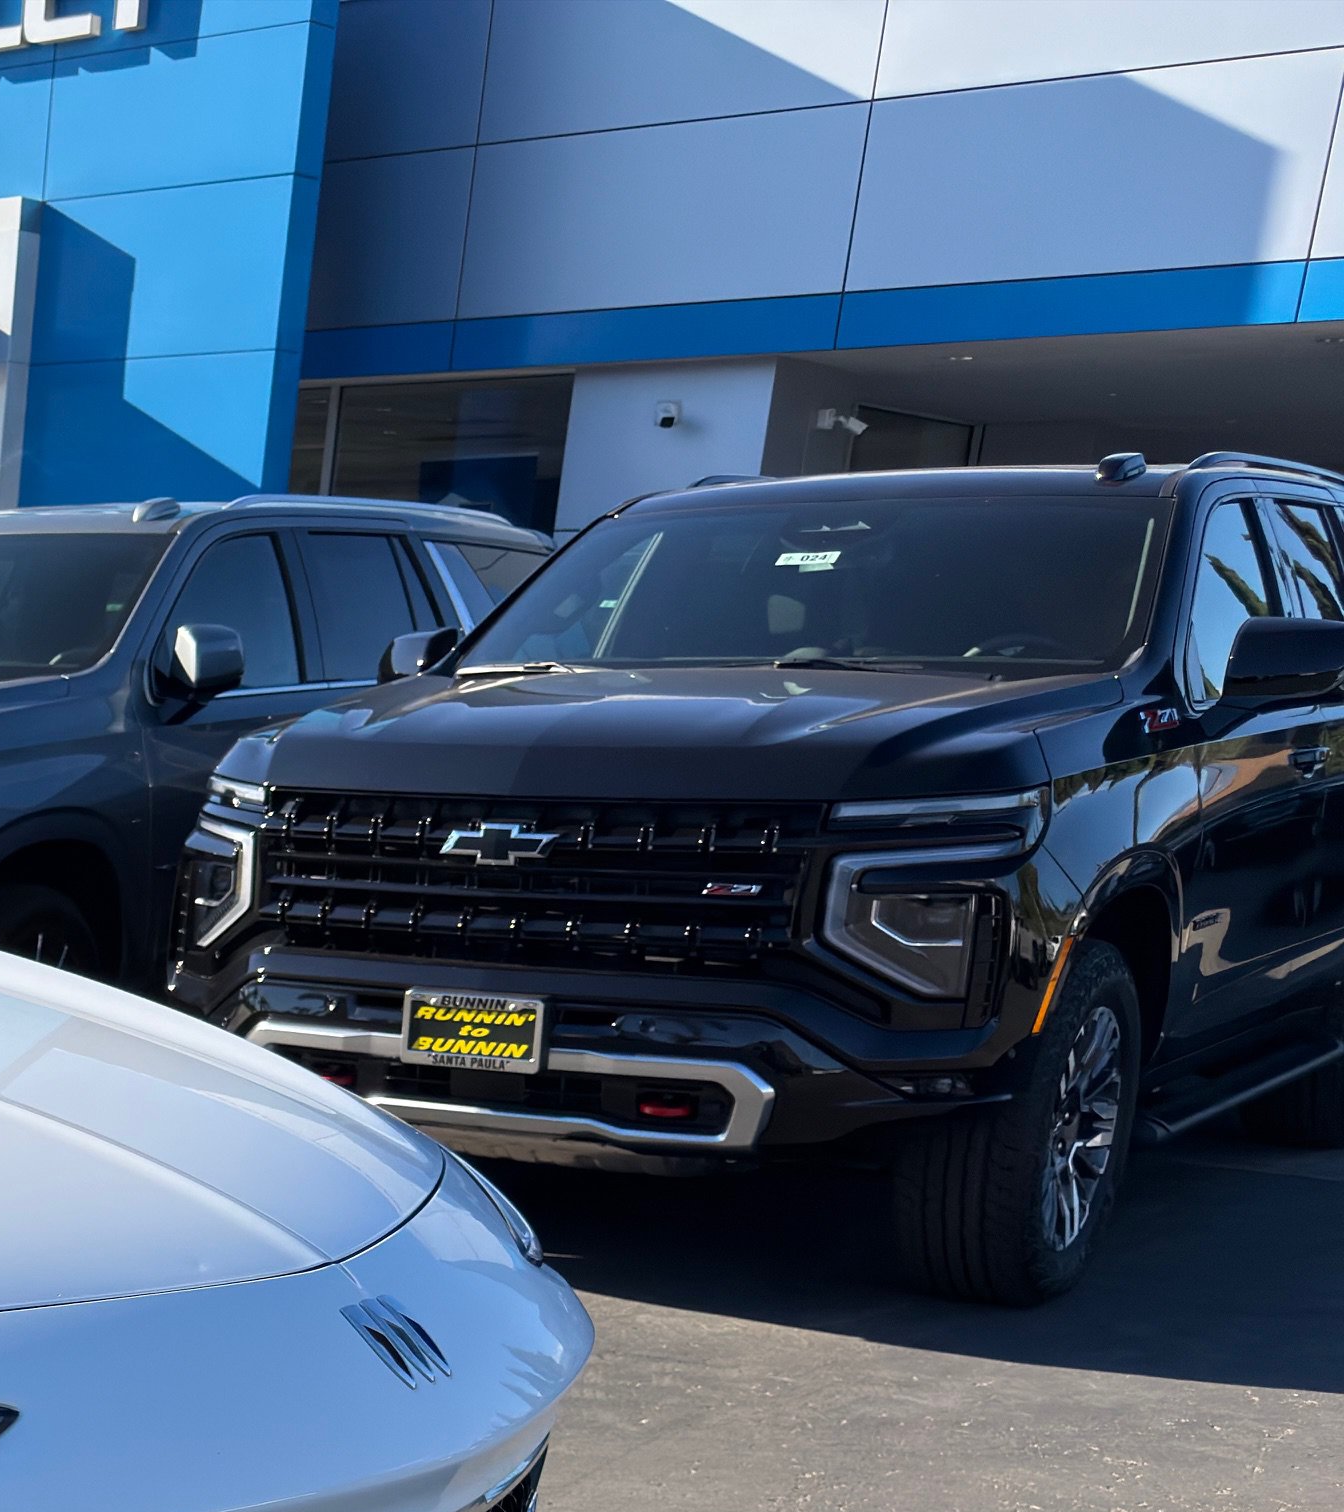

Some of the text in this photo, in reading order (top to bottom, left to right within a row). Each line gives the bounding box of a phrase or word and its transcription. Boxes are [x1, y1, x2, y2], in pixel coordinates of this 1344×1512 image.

[440, 995, 507, 1011] BUNNIN
[414, 1006, 536, 1027] RUNNIN'
[458, 1025, 490, 1038] to
[412, 1036, 529, 1059] BUNNIN
